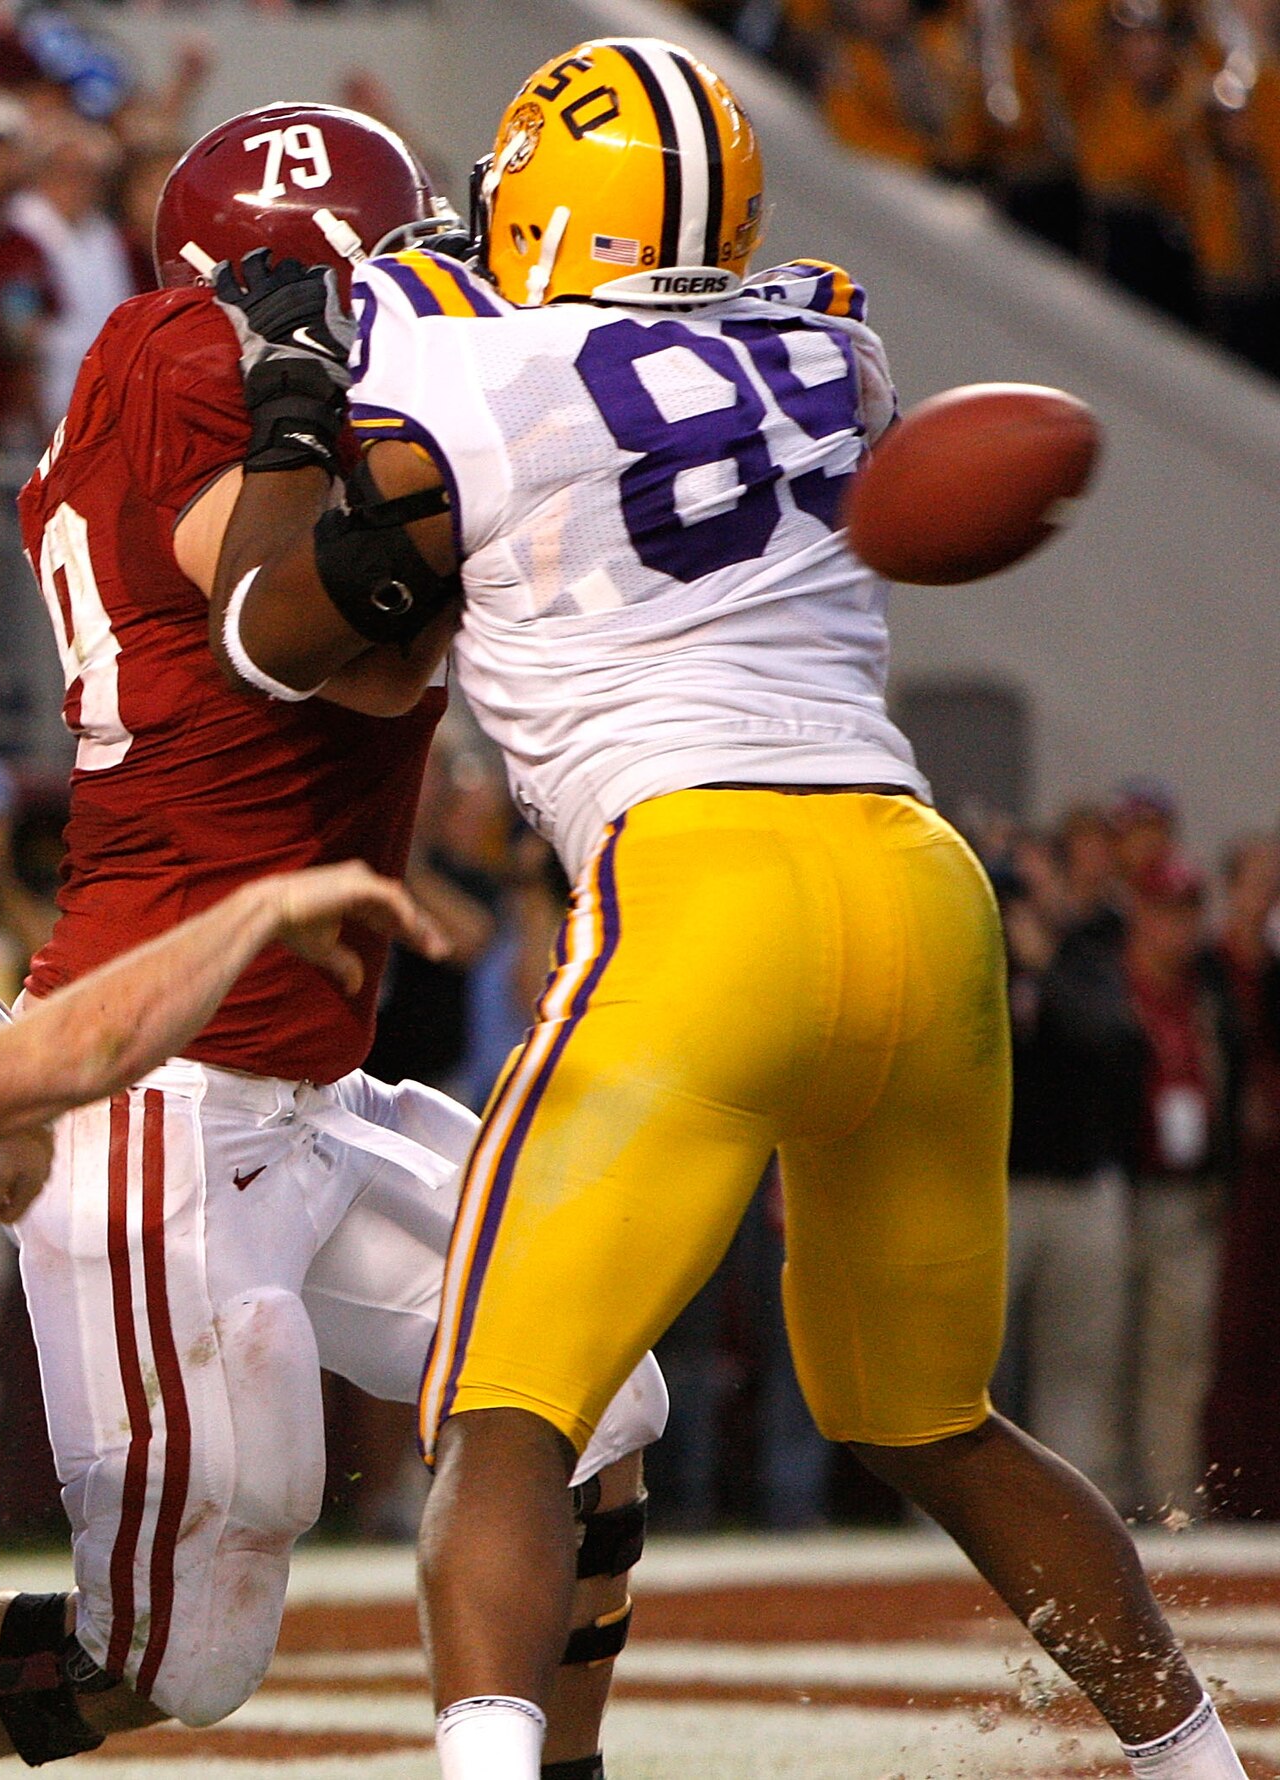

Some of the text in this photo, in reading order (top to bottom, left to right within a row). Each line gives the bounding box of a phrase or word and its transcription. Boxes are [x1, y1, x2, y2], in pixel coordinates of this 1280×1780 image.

[521, 56, 620, 140] SU
[244, 124, 332, 200] 79
[642, 246, 656, 265] 8
[651, 276, 729, 293] TIGERS
[574, 318, 866, 584] 89
[24, 502, 133, 771] 9
